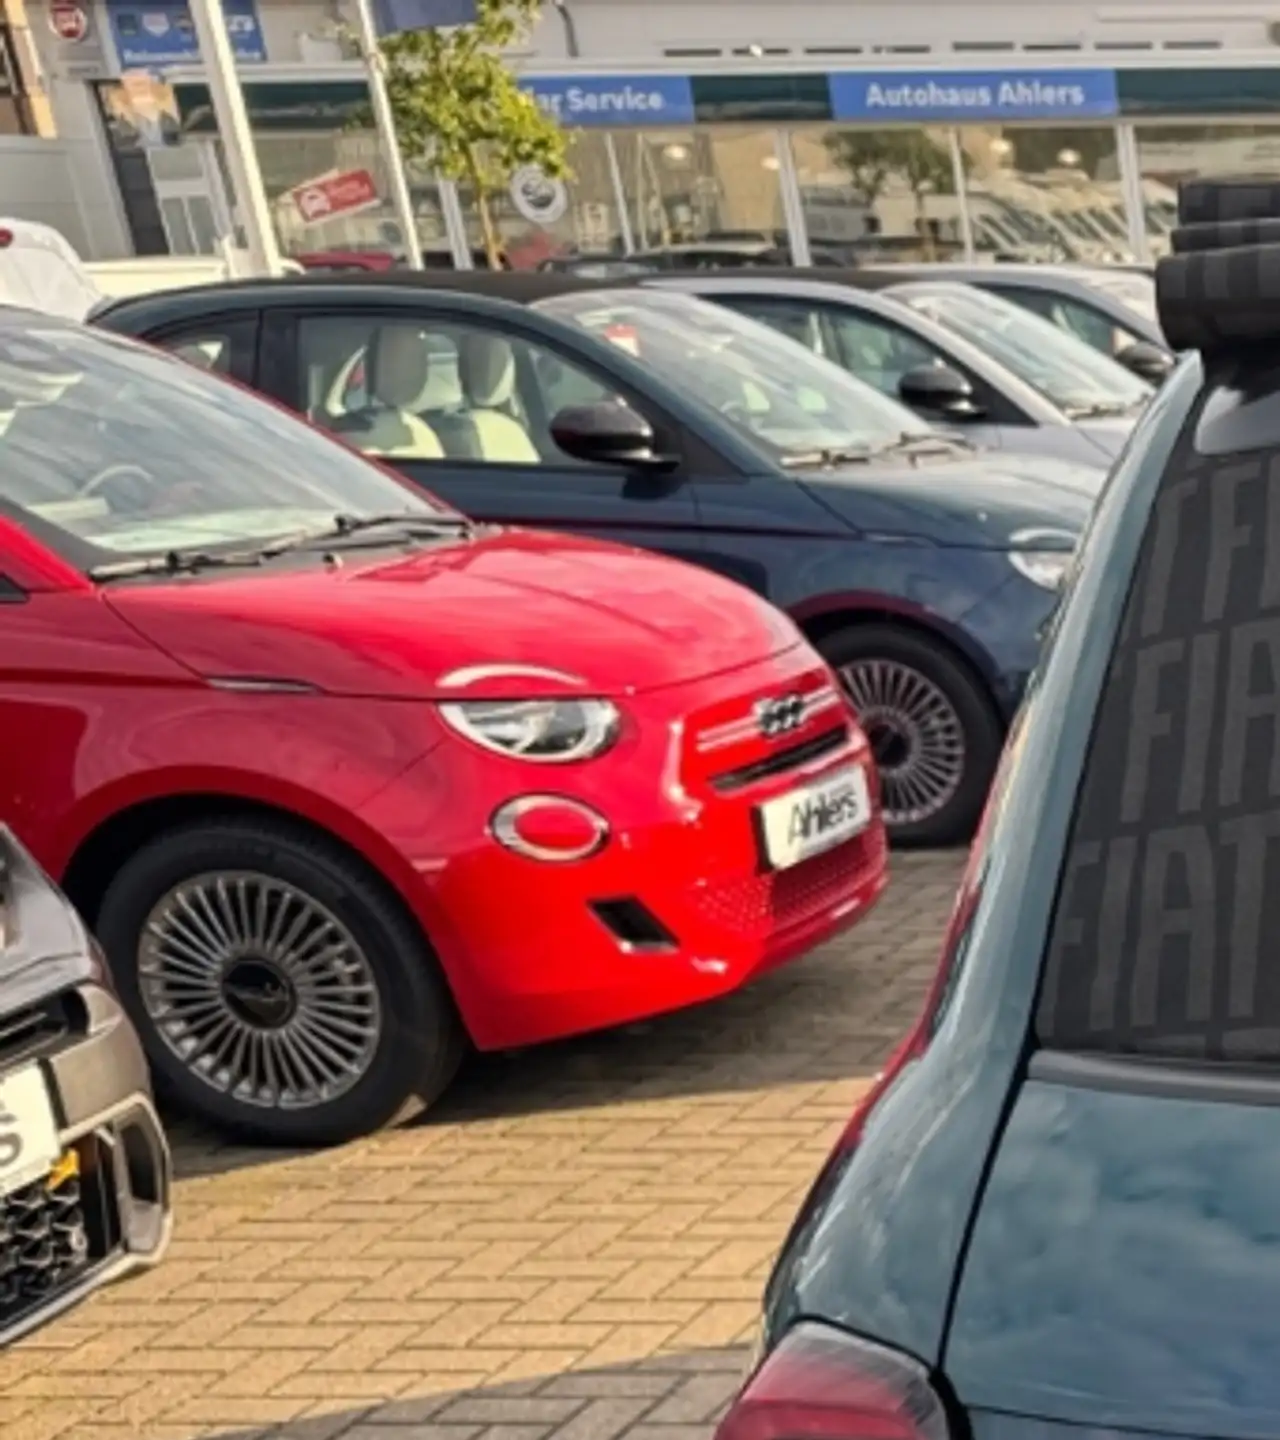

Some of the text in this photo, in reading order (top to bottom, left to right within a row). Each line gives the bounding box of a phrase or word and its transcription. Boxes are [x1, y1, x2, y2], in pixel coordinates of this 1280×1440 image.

[566, 86, 663, 112] Service
[866, 80, 1085, 107] Autohaus Ahlers
